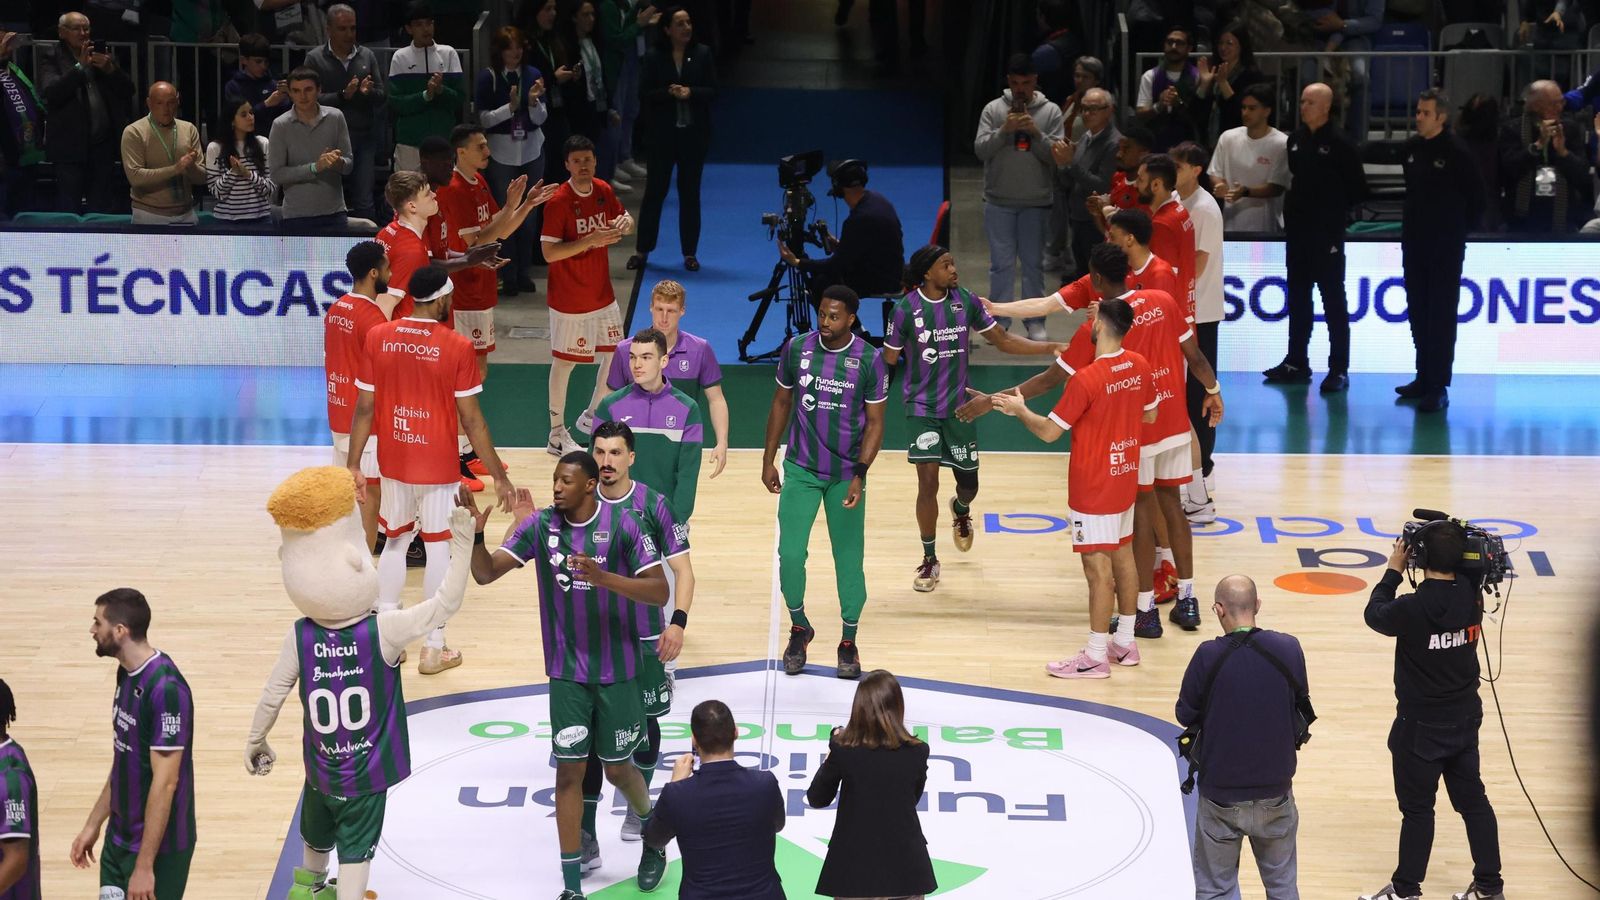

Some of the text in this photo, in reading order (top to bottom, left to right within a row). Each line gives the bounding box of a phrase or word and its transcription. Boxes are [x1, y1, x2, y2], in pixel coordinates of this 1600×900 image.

[0, 70, 27, 113] NCESTO
[46, 252, 354, 316] TÉCNICAS
[1222, 276, 1600, 324] SOUCONES
[815, 376, 855, 389] Fundación
[393, 417, 410, 431] ETL
[393, 430, 429, 445] GLOBAL
[313, 641, 358, 658] Chicui
[308, 685, 371, 735] 00
